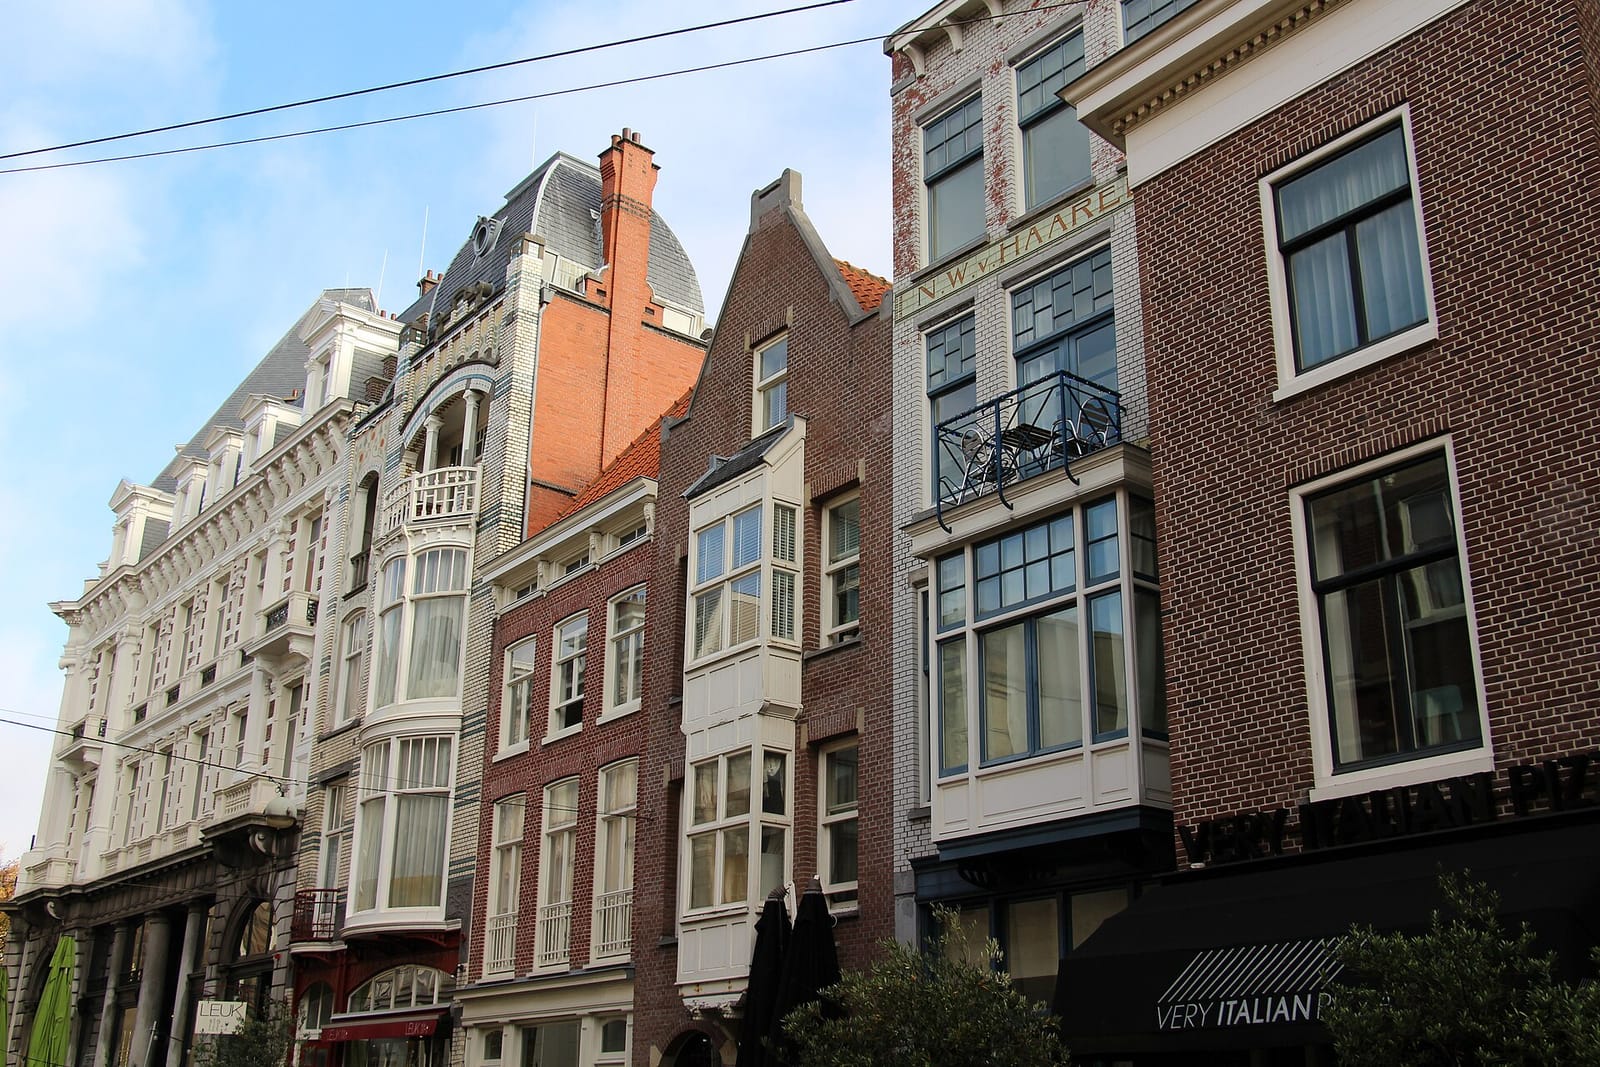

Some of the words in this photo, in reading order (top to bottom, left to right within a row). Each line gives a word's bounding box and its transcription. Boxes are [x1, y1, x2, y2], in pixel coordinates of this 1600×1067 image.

[1176, 808, 1290, 866] VERY
[1302, 772, 1495, 850] ITALIAN
[200, 1002, 243, 1017] LEUK
[1157, 1001, 1214, 1029] VERY
[1217, 993, 1312, 1026] ITALIAN
